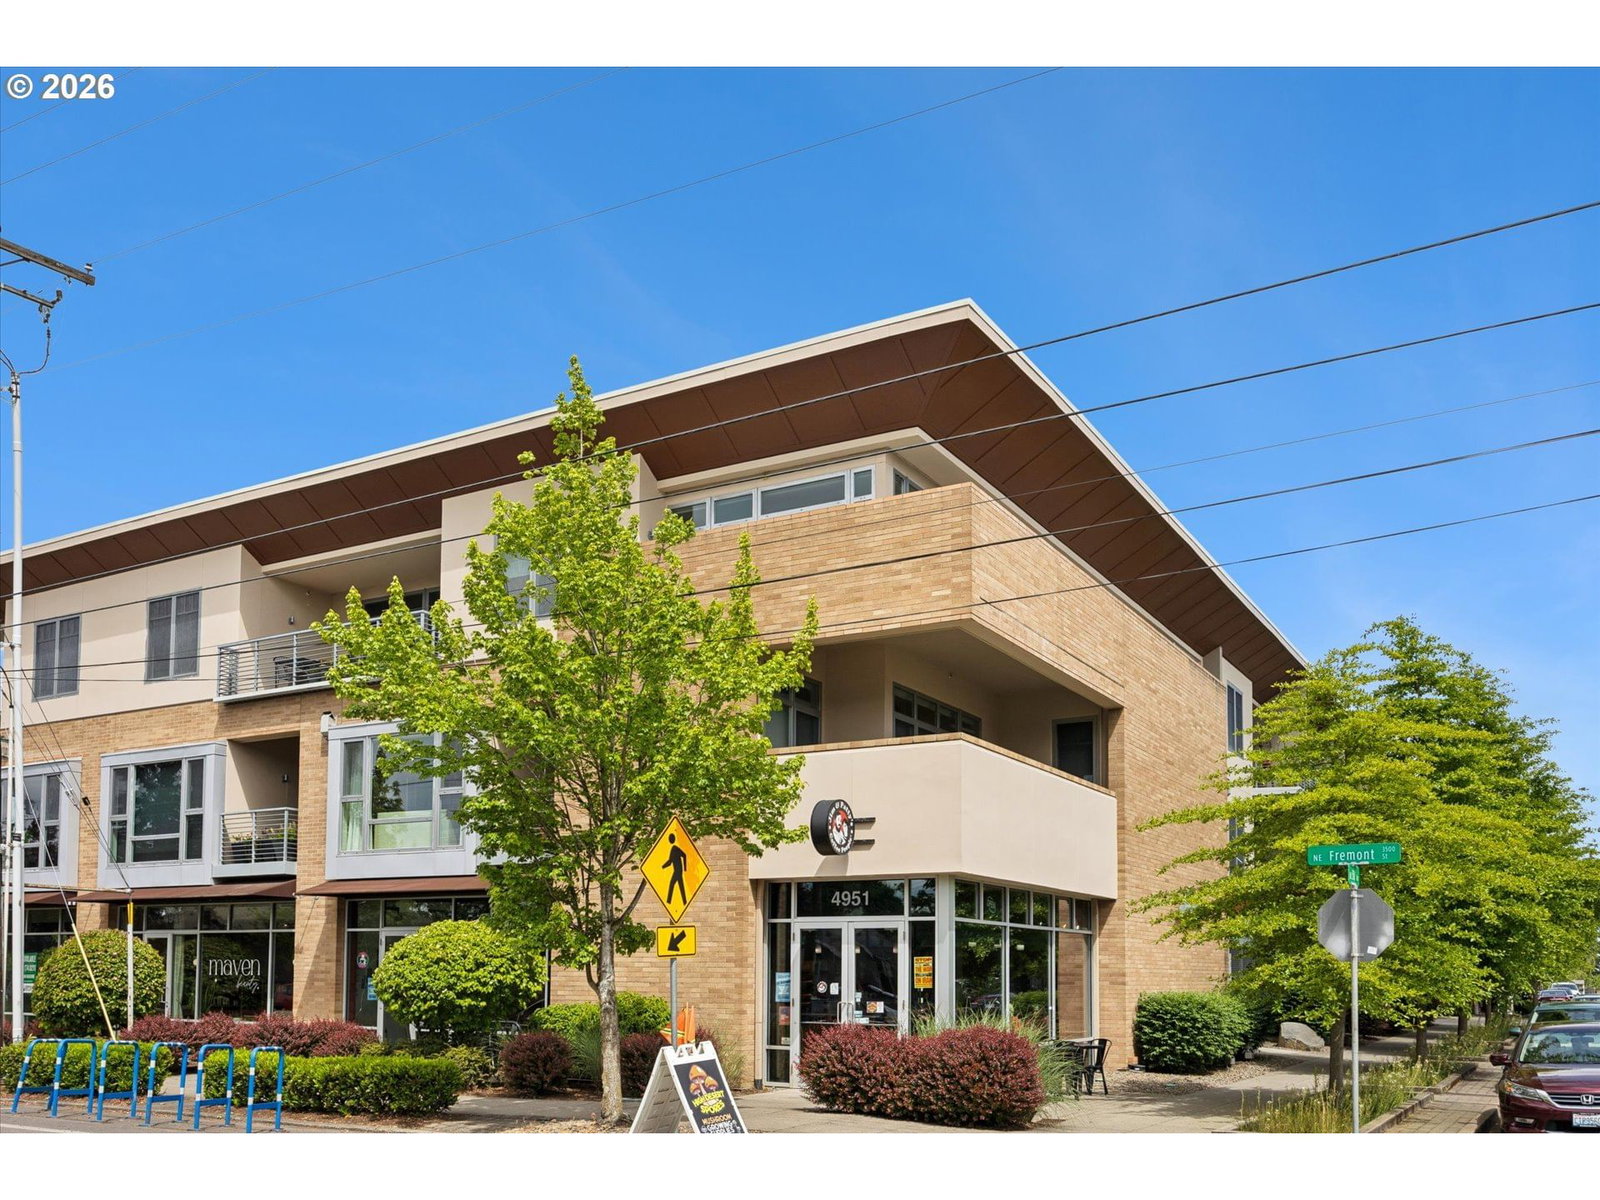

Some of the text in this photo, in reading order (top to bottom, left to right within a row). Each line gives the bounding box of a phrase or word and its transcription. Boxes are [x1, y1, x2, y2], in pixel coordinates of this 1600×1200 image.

[1313, 854, 1322, 862] NE
[1329, 849, 1375, 861] Fremont
[831, 891, 869, 906] 4951
[208, 958, 261, 977] maven
[705, 1090, 725, 1101] DESERT
[700, 1100, 725, 1114] SPORES
[702, 1113, 732, 1125] MUSHROOM
